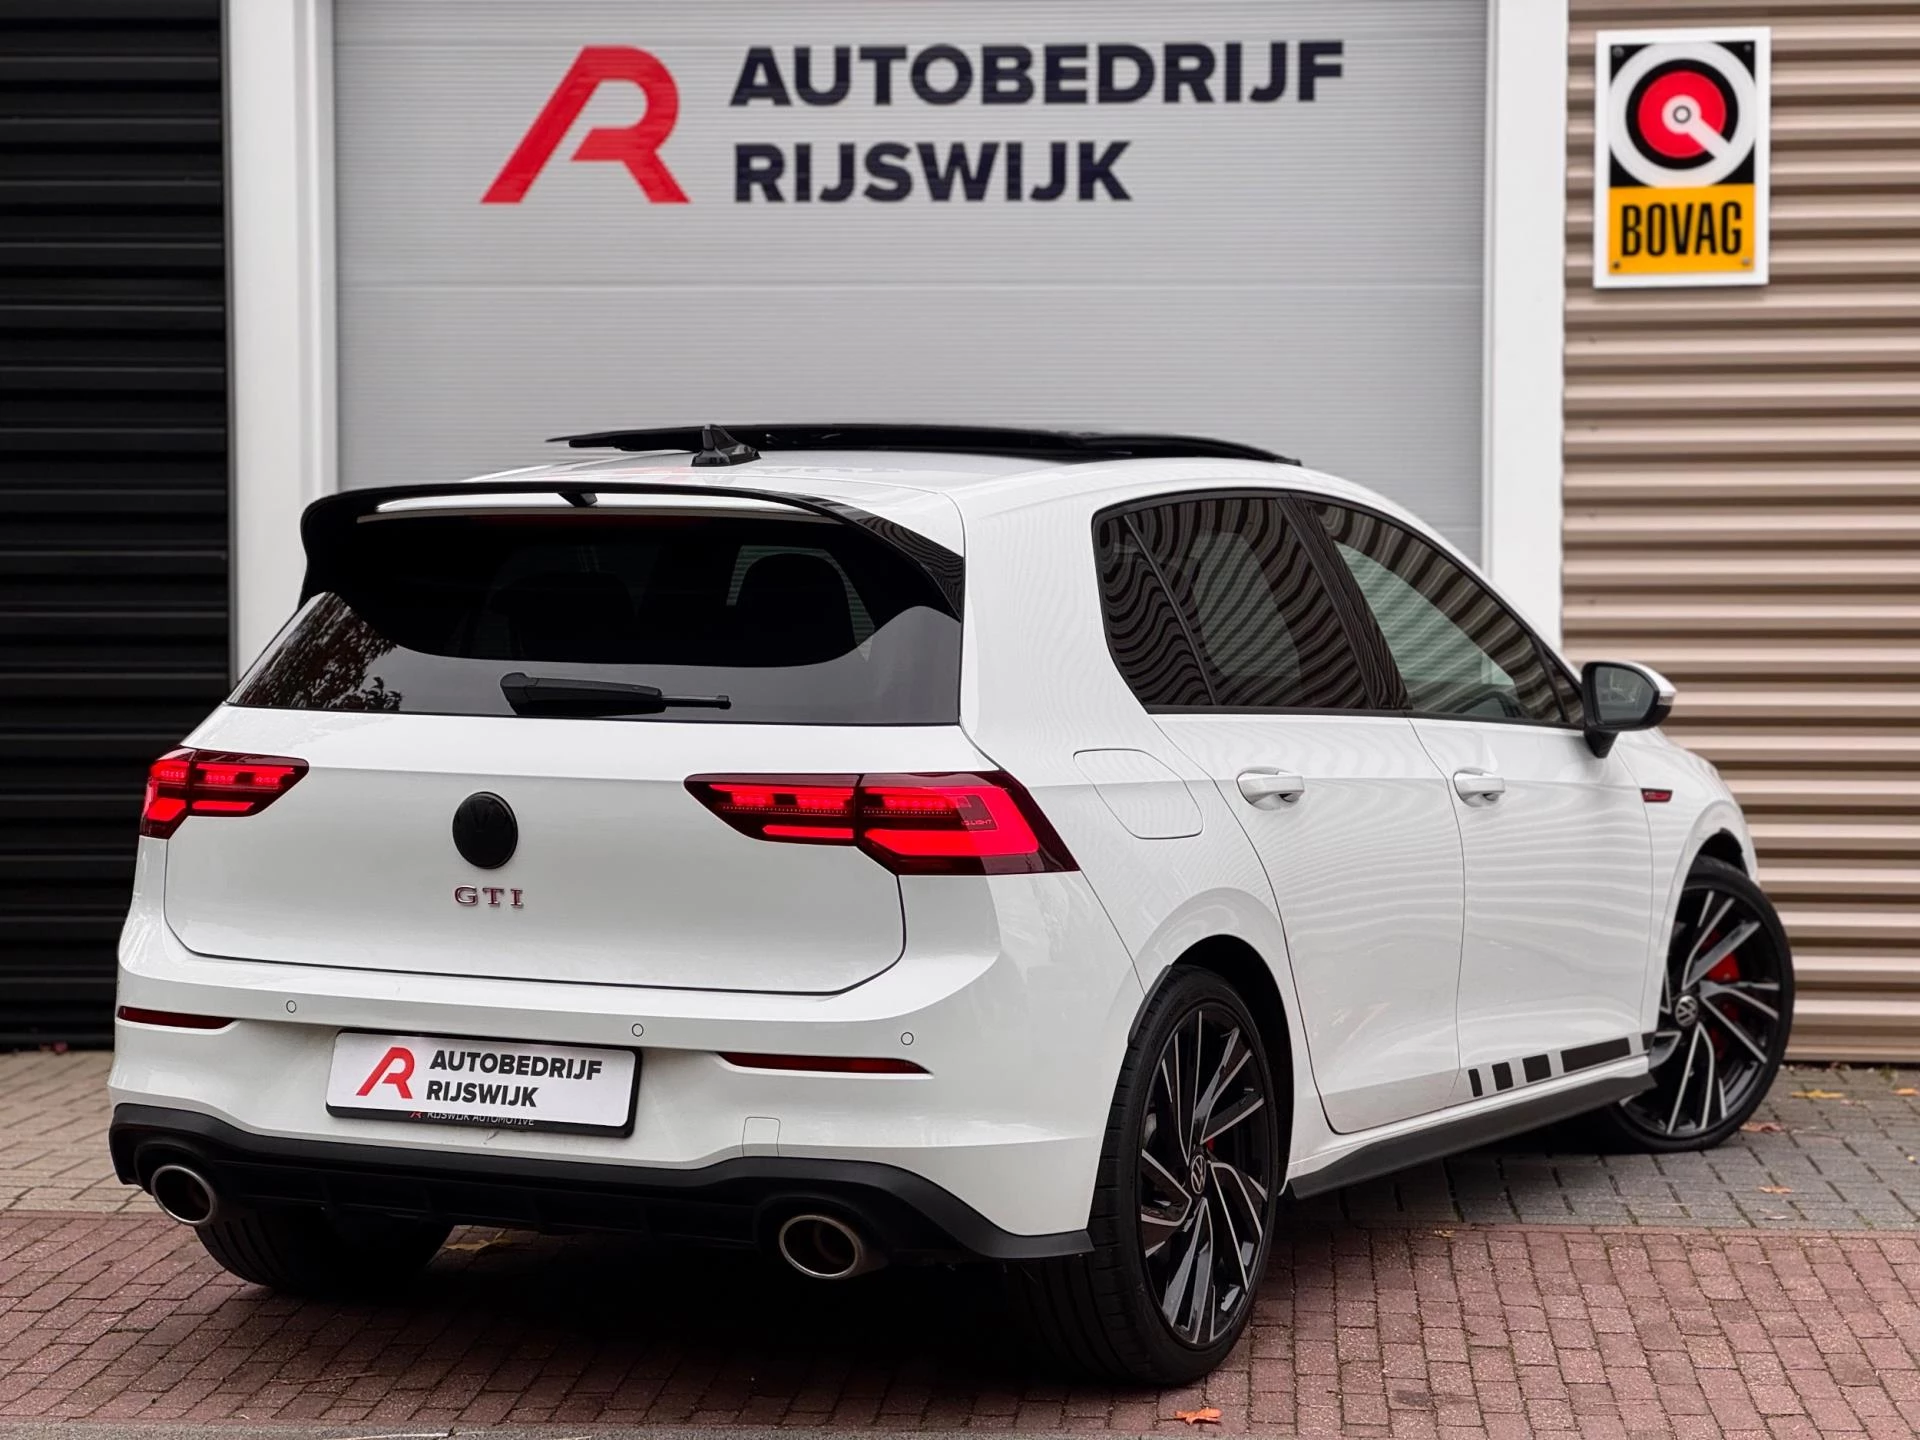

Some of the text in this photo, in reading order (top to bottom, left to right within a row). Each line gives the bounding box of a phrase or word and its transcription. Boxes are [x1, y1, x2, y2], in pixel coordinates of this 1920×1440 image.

[730, 40, 1344, 107] AUTOBEDRIJF
[734, 141, 1131, 202] RIJSWIJK
[1620, 200, 1742, 258] BOVAG
[454, 885, 524, 908] GTI
[429, 1049, 603, 1080] AUTOBEDRIJF
[426, 1080, 539, 1108] RIJSWIJK
